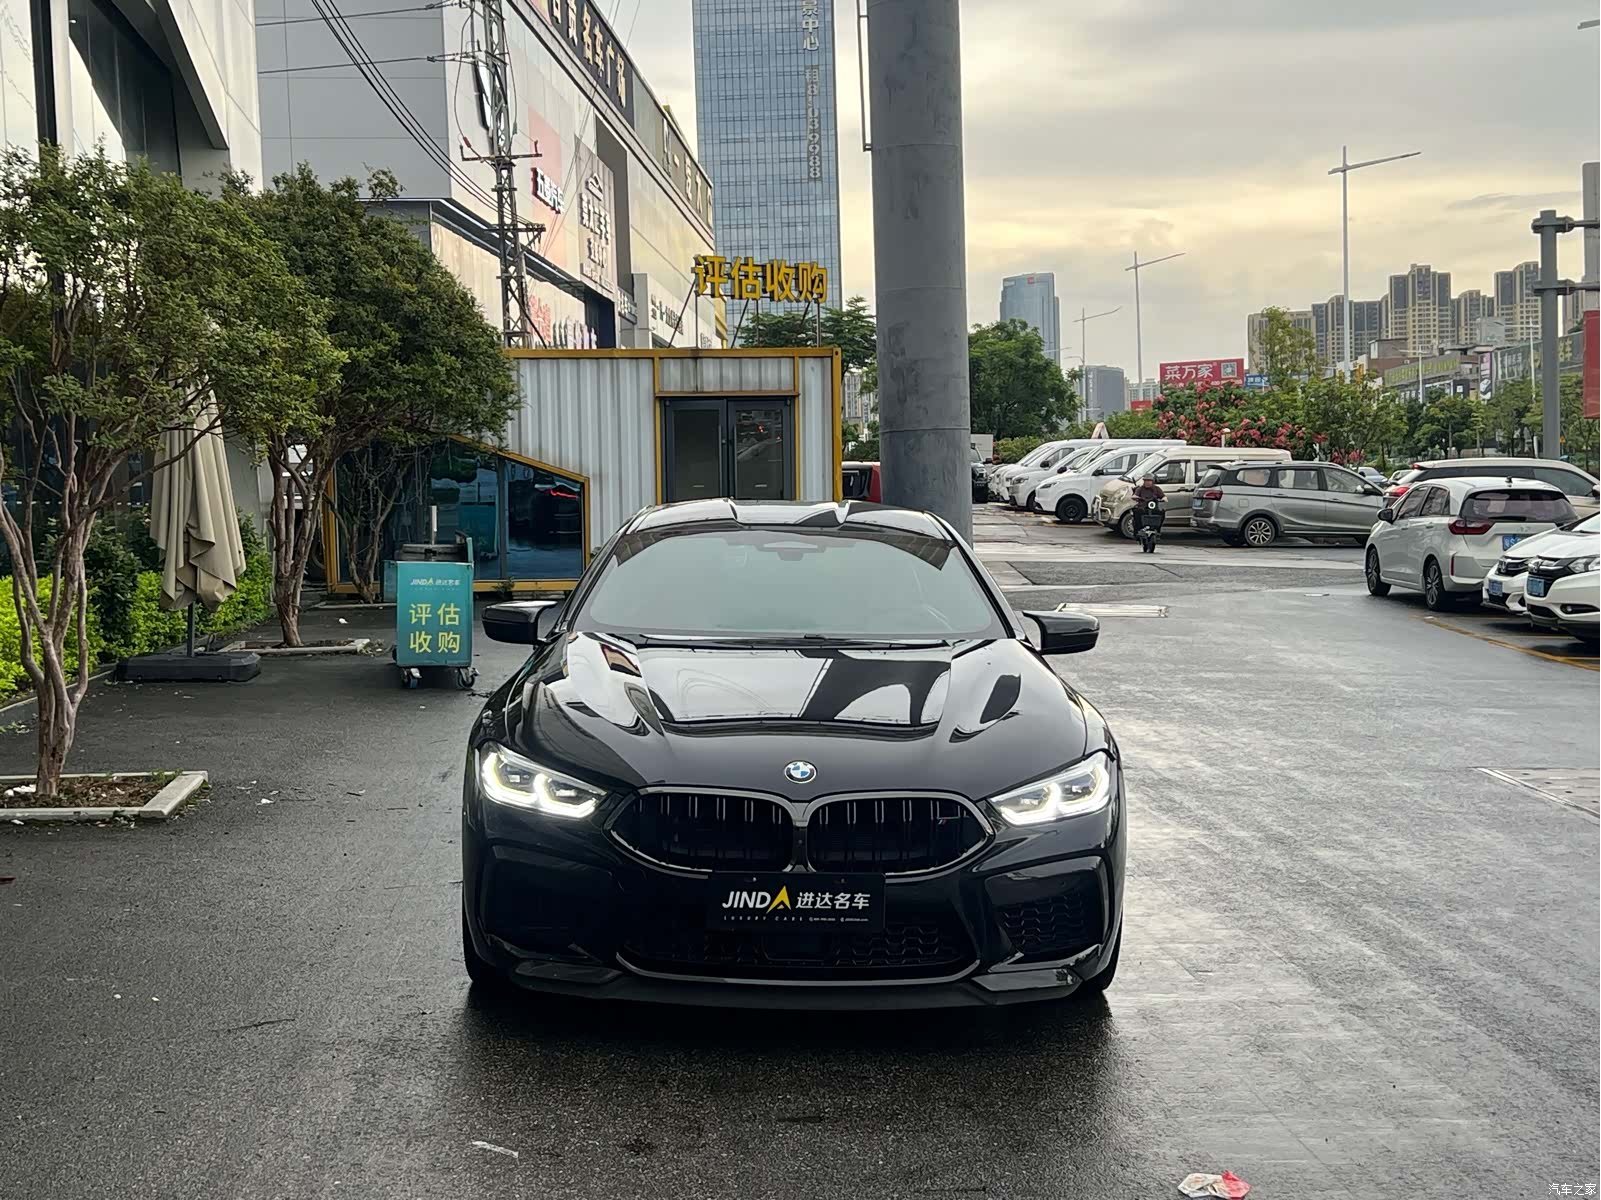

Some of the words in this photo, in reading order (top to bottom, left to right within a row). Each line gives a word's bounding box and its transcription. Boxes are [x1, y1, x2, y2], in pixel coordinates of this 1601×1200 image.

[692, 254, 828, 303] 评估收购
[1165, 364, 1213, 380] 菜万家
[409, 603, 460, 625] 评估
[409, 631, 460, 654] 收购
[722, 885, 791, 914] JINDA
[795, 892, 871, 910] 进达名车
